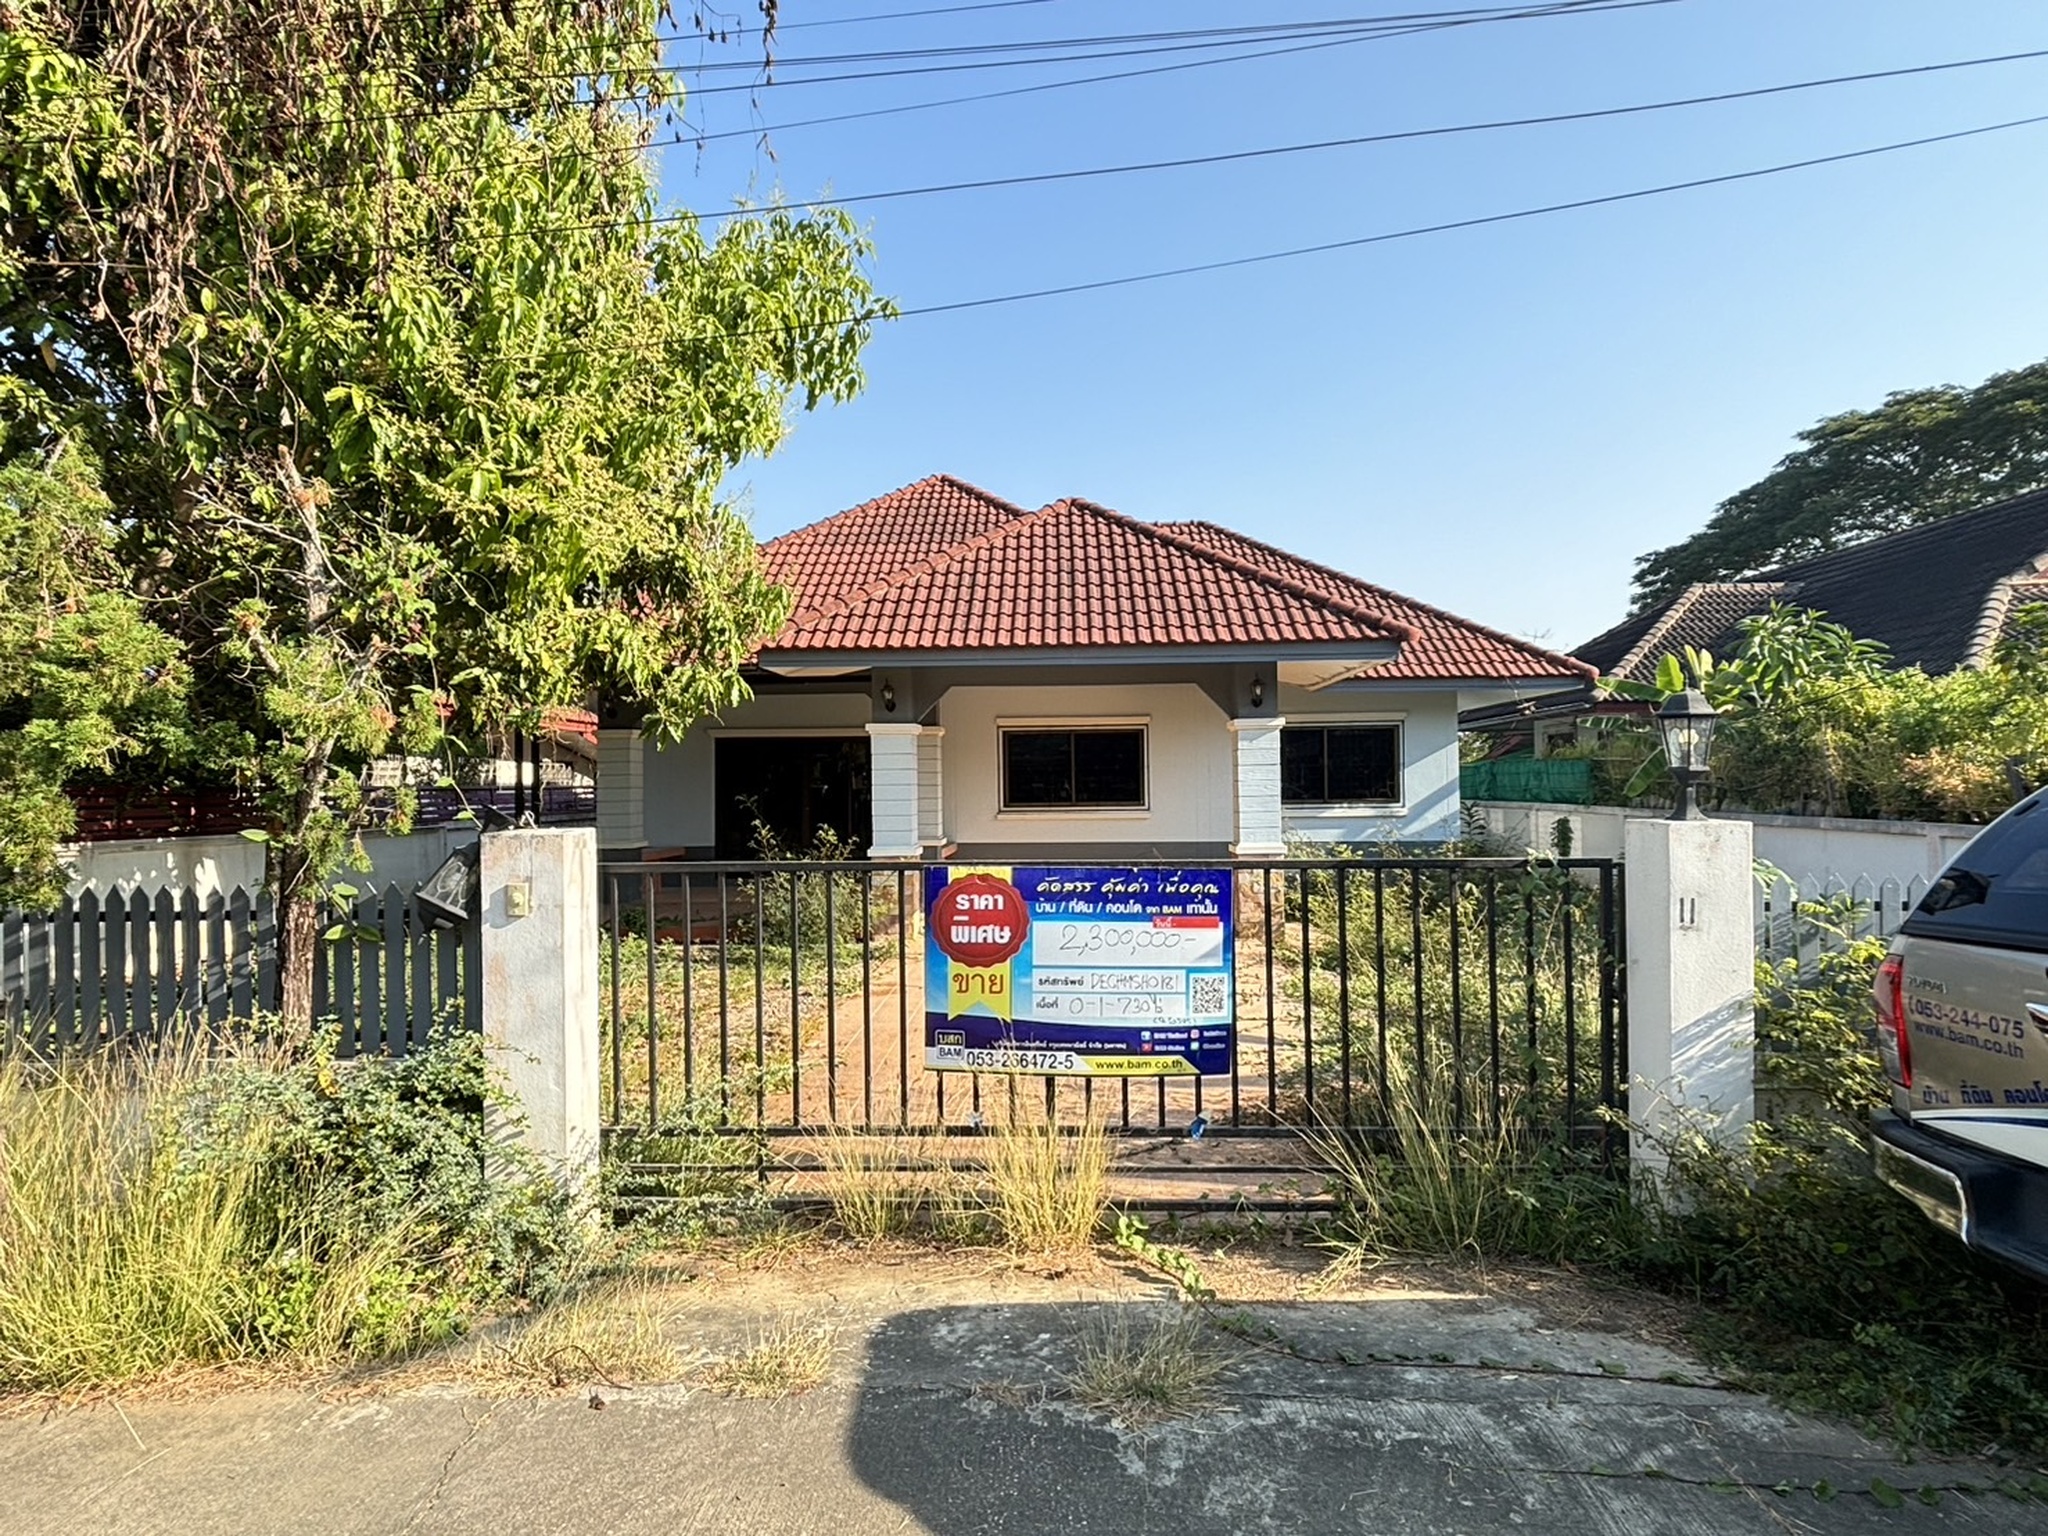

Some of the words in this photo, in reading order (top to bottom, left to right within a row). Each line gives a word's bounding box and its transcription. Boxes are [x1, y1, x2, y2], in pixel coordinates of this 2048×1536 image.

[955, 894, 1004, 910] ราคา
[950, 915, 1011, 944] พิเศษ
[952, 973, 1004, 995] ขาย
[939, 1047, 962, 1057] BAM
[1095, 1058, 1183, 1070] www.bam.co.th
